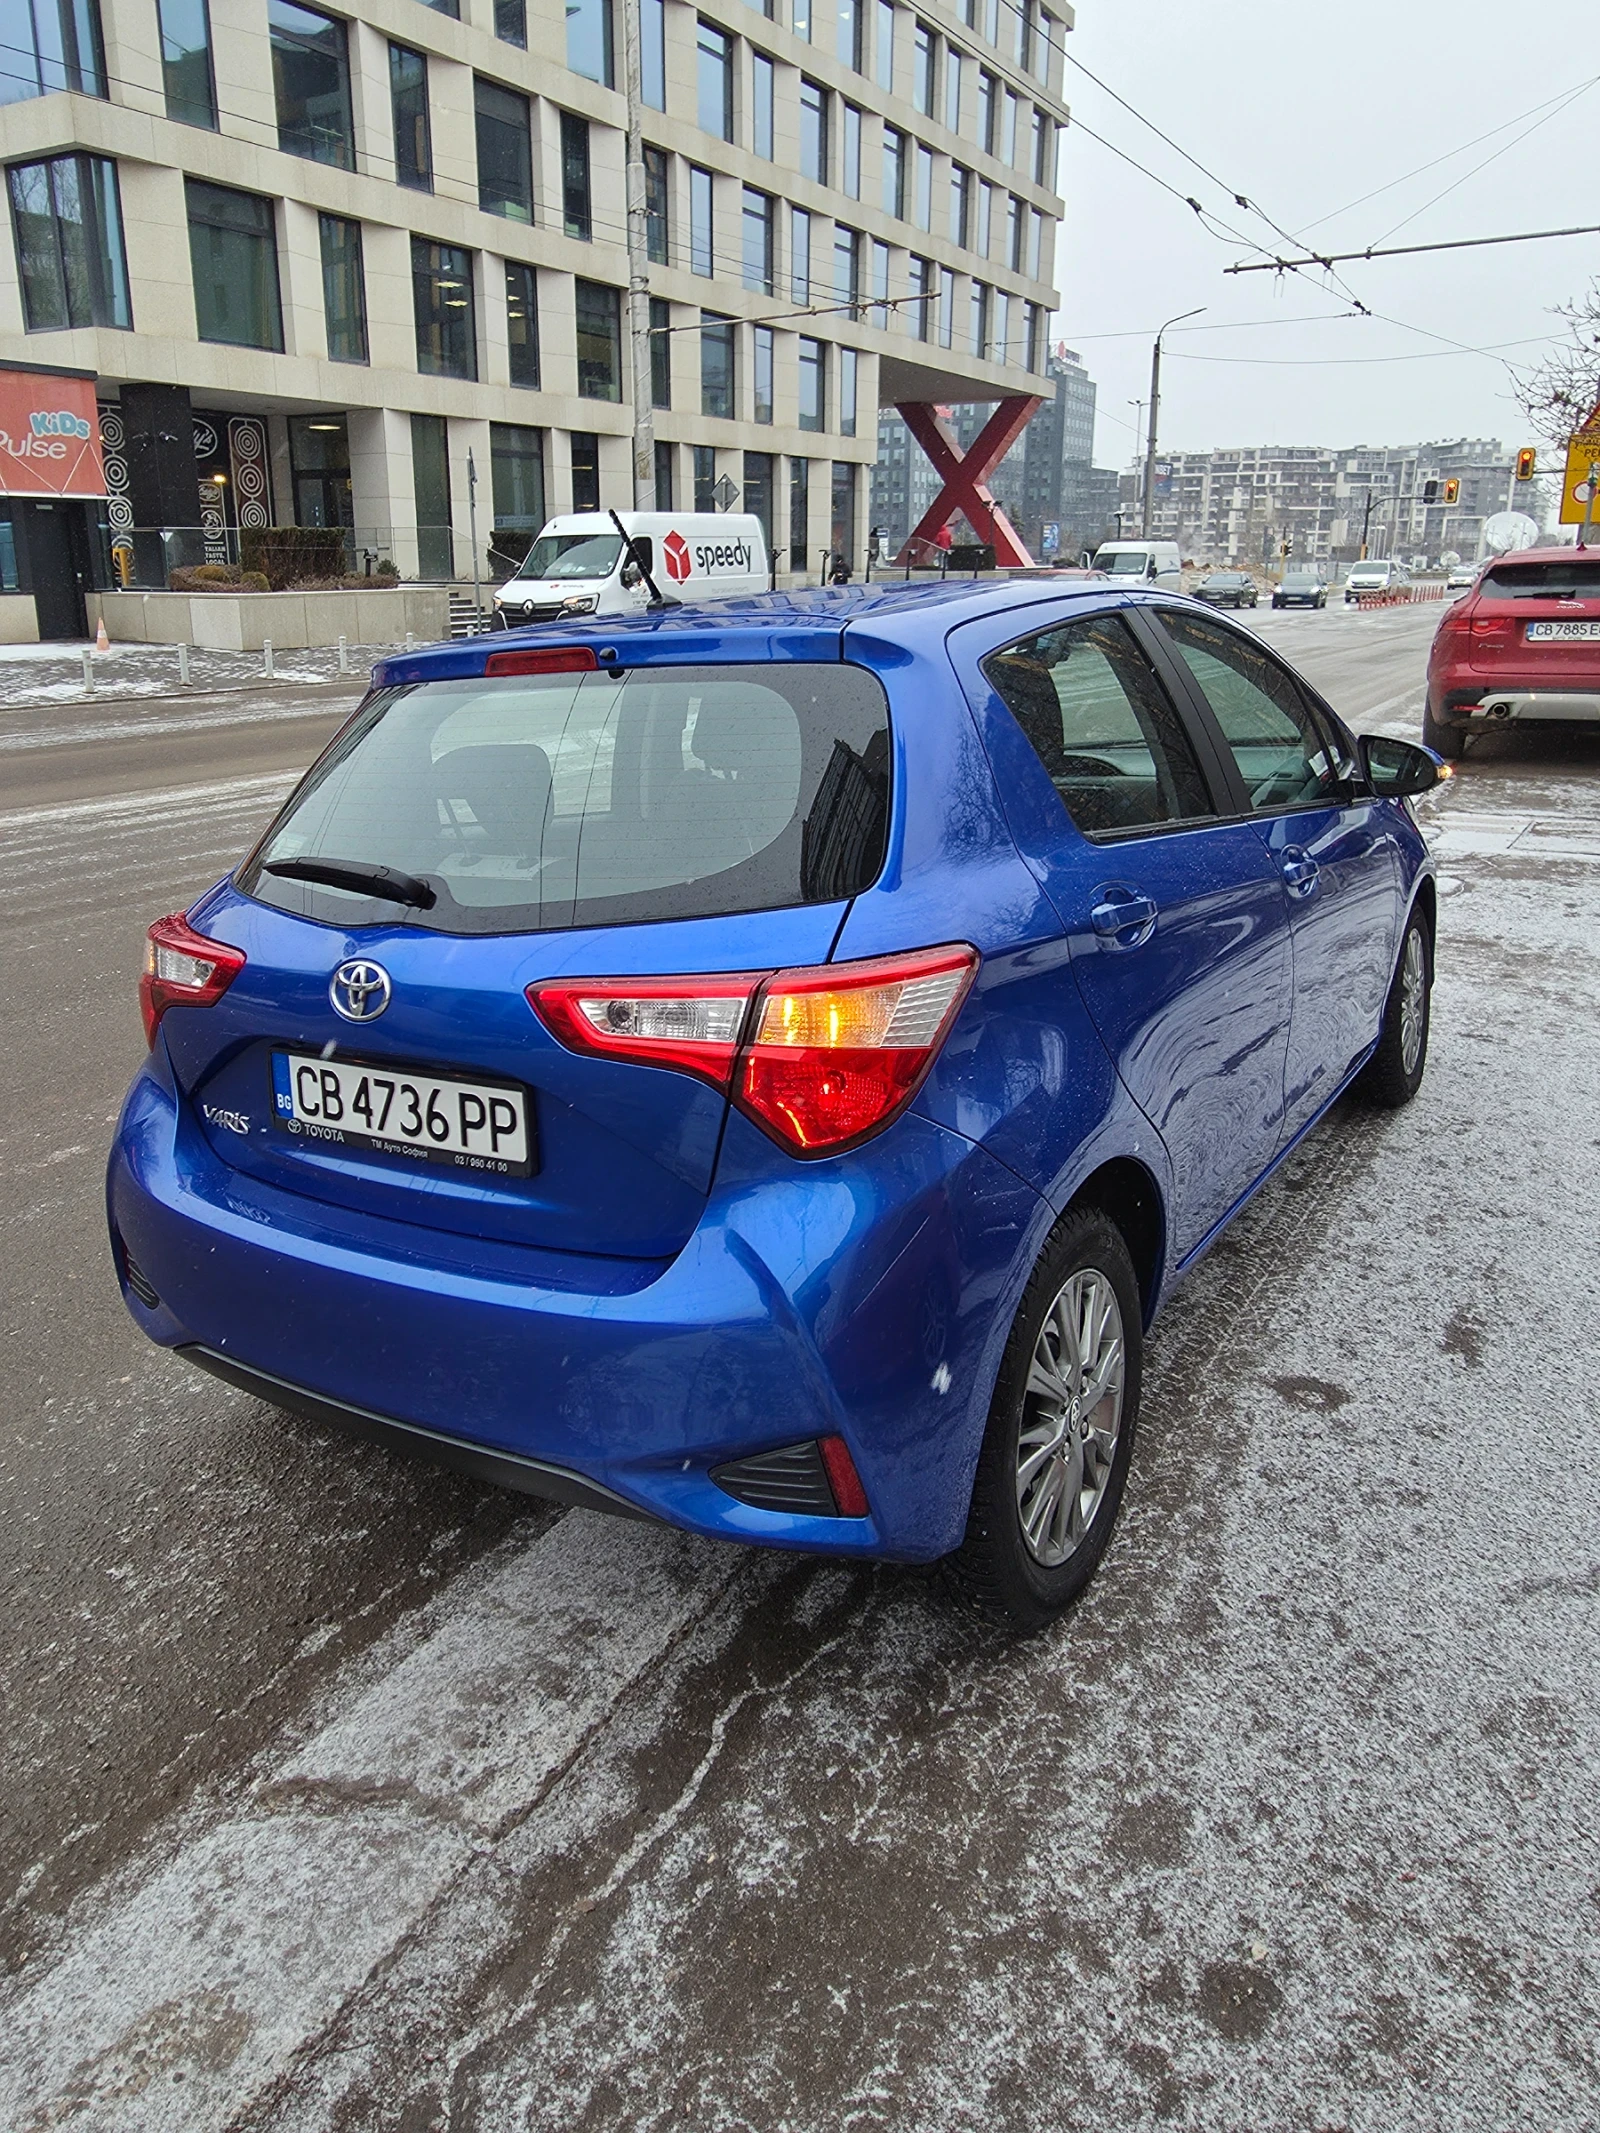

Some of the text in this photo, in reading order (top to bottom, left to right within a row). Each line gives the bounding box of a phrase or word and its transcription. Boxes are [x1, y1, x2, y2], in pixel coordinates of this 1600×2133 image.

[695, 537, 751, 575] speedy
[1535, 624, 1600, 636] CB 7885 E
[276, 1093, 292, 1110] BG
[296, 1065, 517, 1153] CB 4736 PP
[304, 1123, 345, 1143] TOYOTA
[402, 1145, 428, 1159] София
[454, 1154, 465, 1165] 02
[485, 1160, 496, 1170] 41
[497, 1161, 508, 1172] 00
